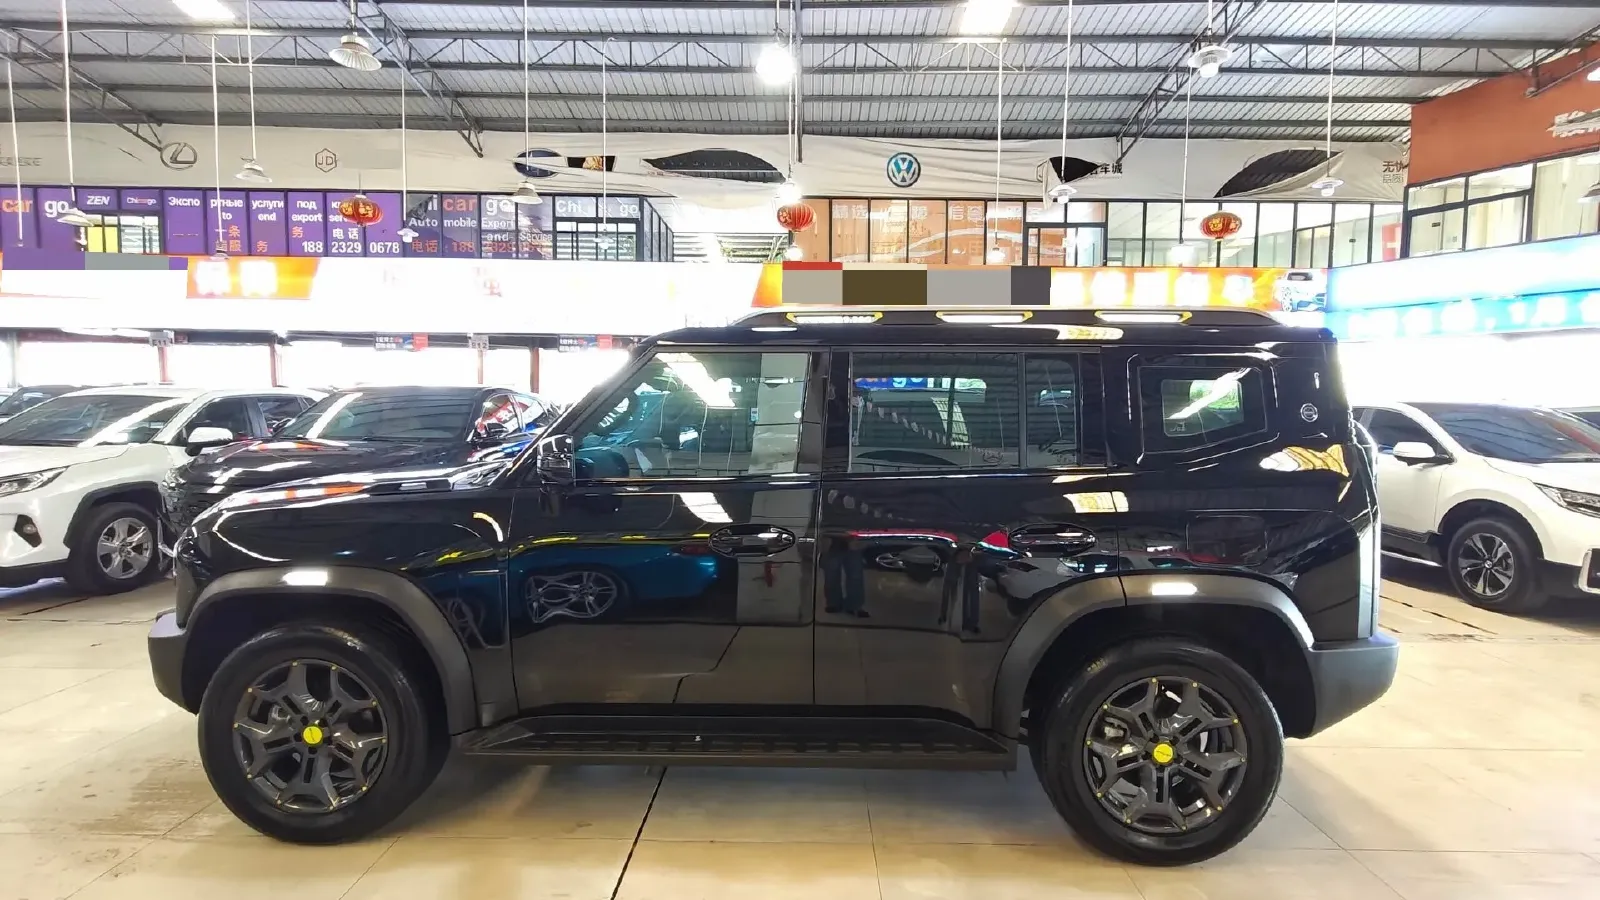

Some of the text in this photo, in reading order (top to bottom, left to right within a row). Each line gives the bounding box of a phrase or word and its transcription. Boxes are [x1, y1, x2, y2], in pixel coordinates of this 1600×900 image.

[318, 156, 334, 166] JD
[87, 195, 111, 206] ZEN
[168, 196, 201, 207] Экспо
[296, 200, 318, 210] под
[443, 198, 478, 213] car
[2, 199, 69, 218] car go
[222, 211, 233, 221] to
[291, 212, 323, 223] export
[408, 217, 439, 228] Auto
[443, 217, 478, 229] mobile
[487, 231, 509, 241] and
[302, 240, 401, 254] 188 2329 0678
